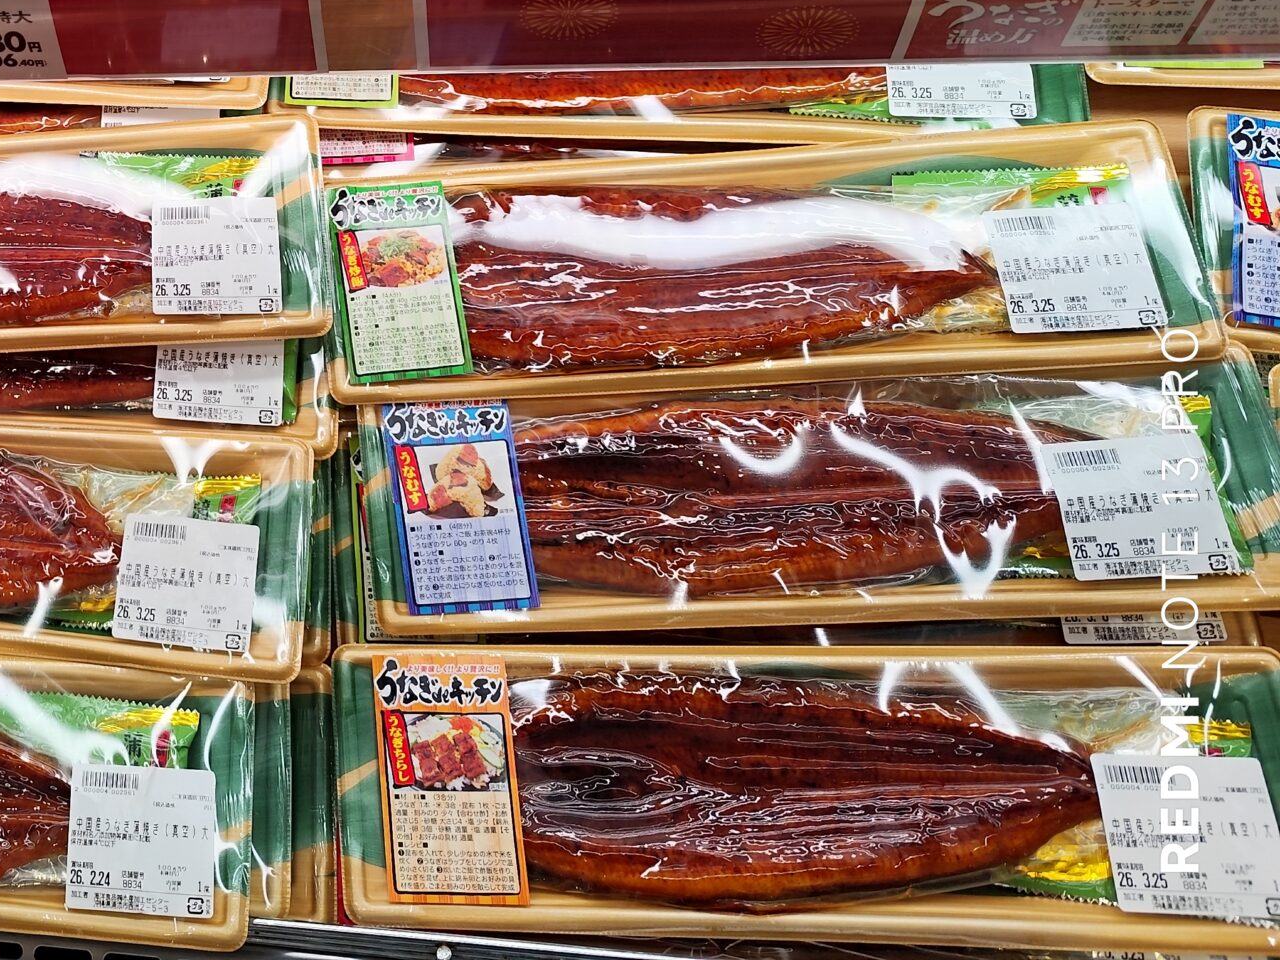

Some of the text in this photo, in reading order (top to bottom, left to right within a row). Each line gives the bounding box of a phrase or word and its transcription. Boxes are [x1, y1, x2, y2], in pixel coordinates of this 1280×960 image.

[1241, 167, 1265, 220] うなむす
[341, 232, 365, 290] うなぎ炒飯
[399, 451, 423, 506] うなむす
[387, 715, 411, 783] うなぎちらし
